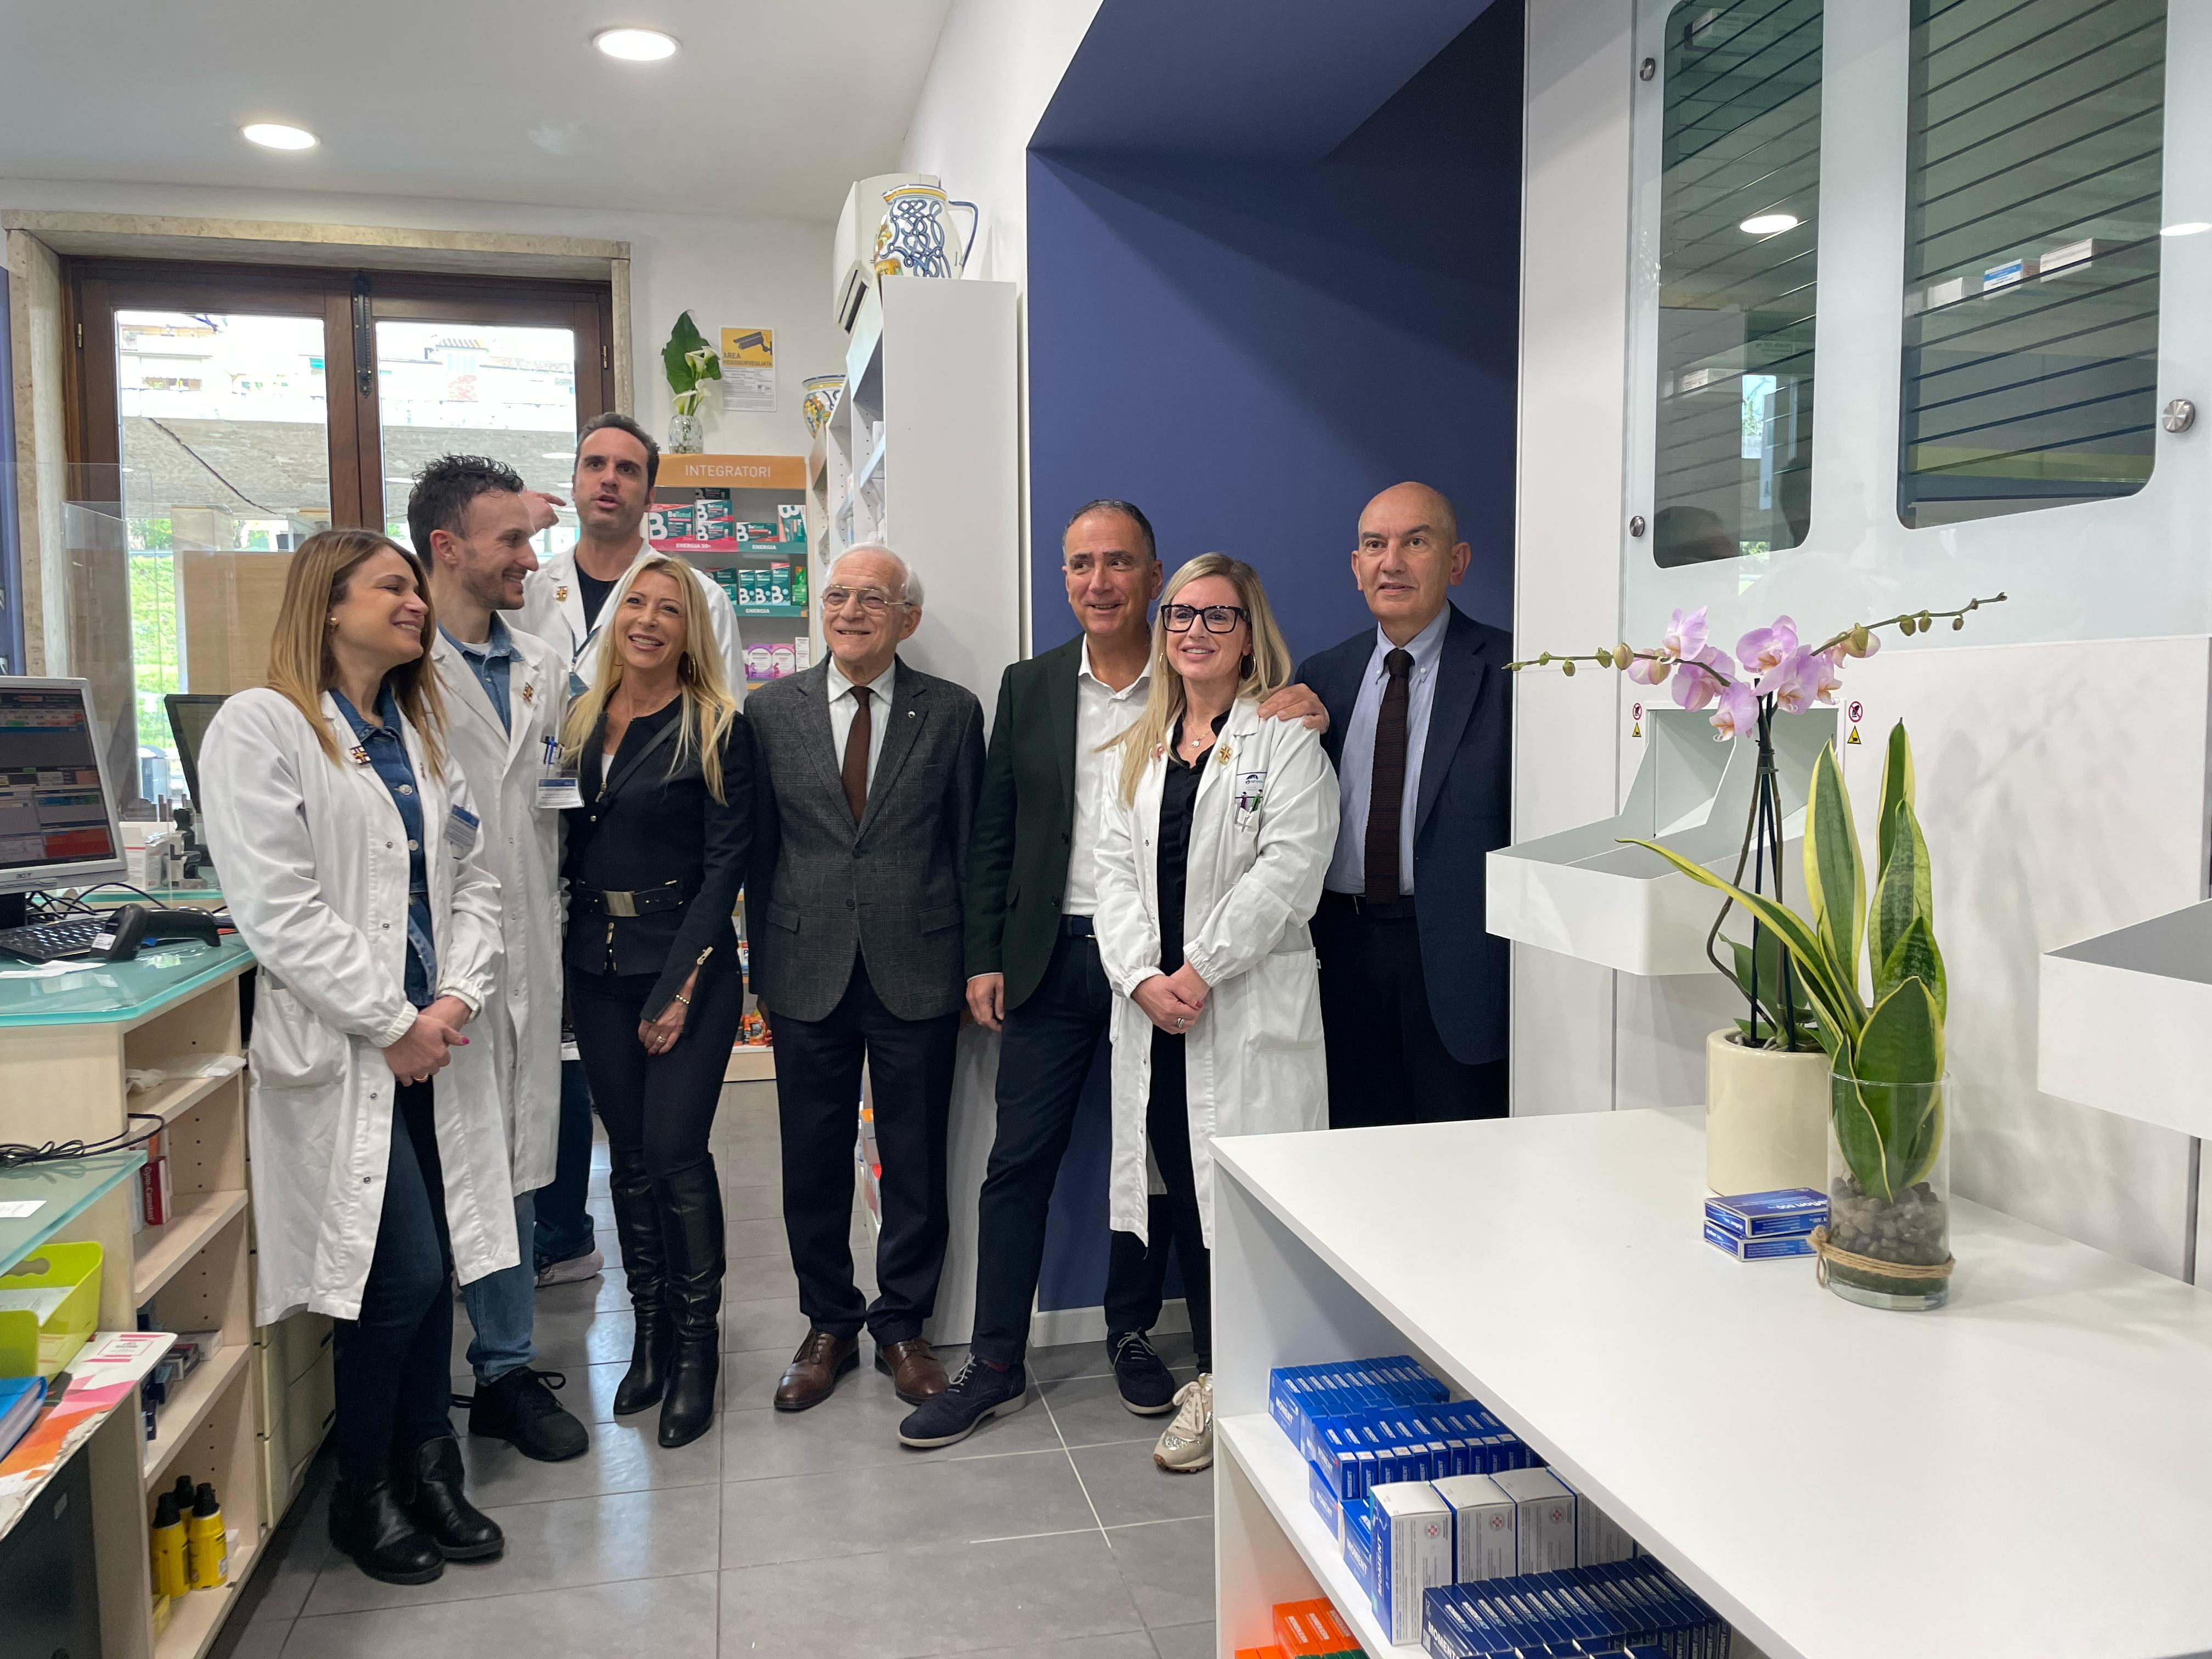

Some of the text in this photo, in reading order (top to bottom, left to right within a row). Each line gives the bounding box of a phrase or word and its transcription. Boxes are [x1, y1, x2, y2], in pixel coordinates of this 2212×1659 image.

[685, 465, 771, 478] INTEGRATORI
[649, 512, 668, 540] B
[737, 524, 749, 541] B
[771, 585, 784, 604] B
[1276, 1396, 1293, 1425] MOMENT
[1347, 1538, 1367, 1576] MOMENT
[1428, 1621, 1456, 1659] MOMENT
